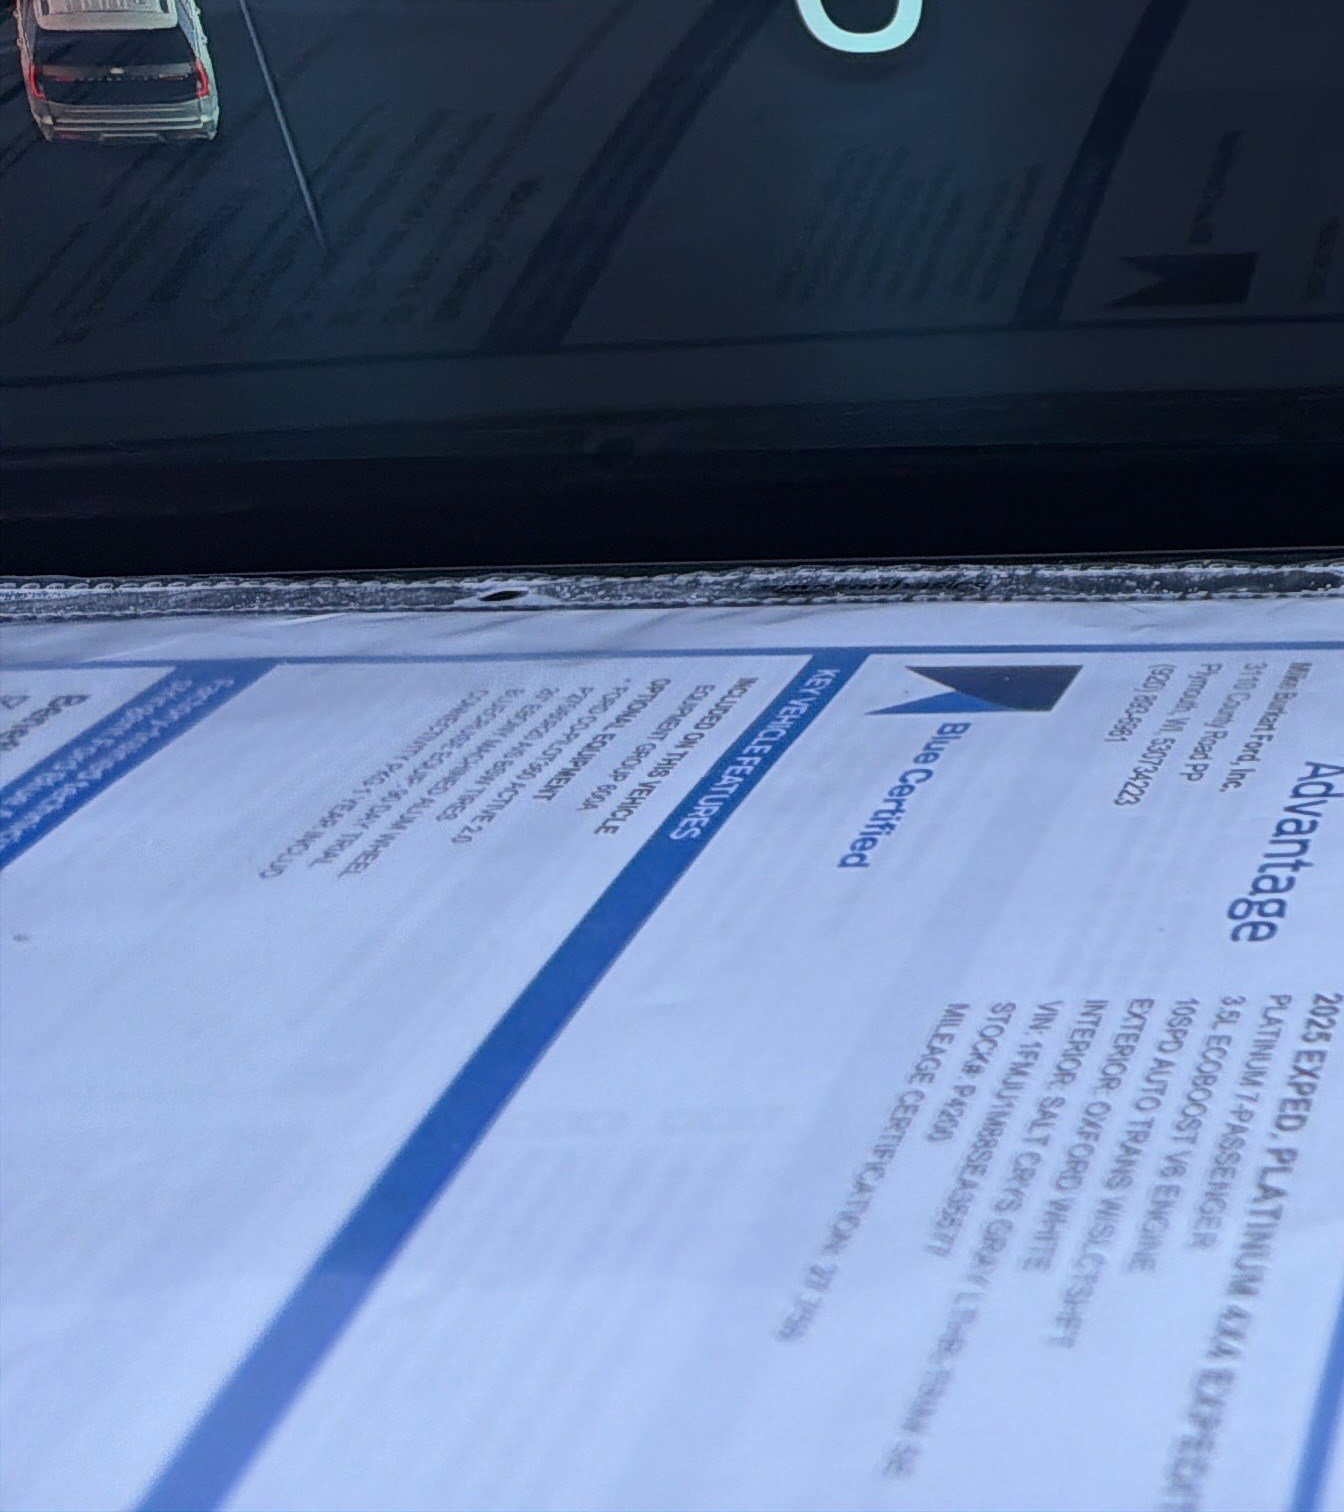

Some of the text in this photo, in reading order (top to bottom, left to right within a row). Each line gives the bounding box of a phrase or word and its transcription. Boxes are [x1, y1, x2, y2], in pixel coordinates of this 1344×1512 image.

[529, 678, 673, 800] OPTIONAL EQUIPMENT
[645, 684, 717, 740] EQUIPMENT
[1204, 692, 1251, 729] County
[591, 678, 759, 835] INCLUDED ON THIS VEHICLE
[604, 742, 658, 781] GROUP
[669, 668, 841, 841] KEY VEHICLE FEATURES
[1180, 763, 1210, 782] PP
[1189, 730, 1229, 761] Road
[1230, 734, 1274, 766] Ford,
[471, 781, 527, 823] ACTIVE
[1219, 768, 1256, 792] Inc.
[837, 768, 934, 868] Certified
[906, 1003, 972, 1083] MILEAGE
[1238, 994, 1292, 1085] PLATINUM
[1132, 1057, 1177, 1111] AUTO
[1168, 1035, 1233, 1145] ECOBOOST
[1021, 1097, 1067, 1146] SALT
[1052, 1100, 1113, 1189] OXFORD
[992, 1152, 1044, 1212] CRYS
[1103, 1117, 1156, 1189] TRANS
[1224, 1148, 1301, 1296] PLATINUM
